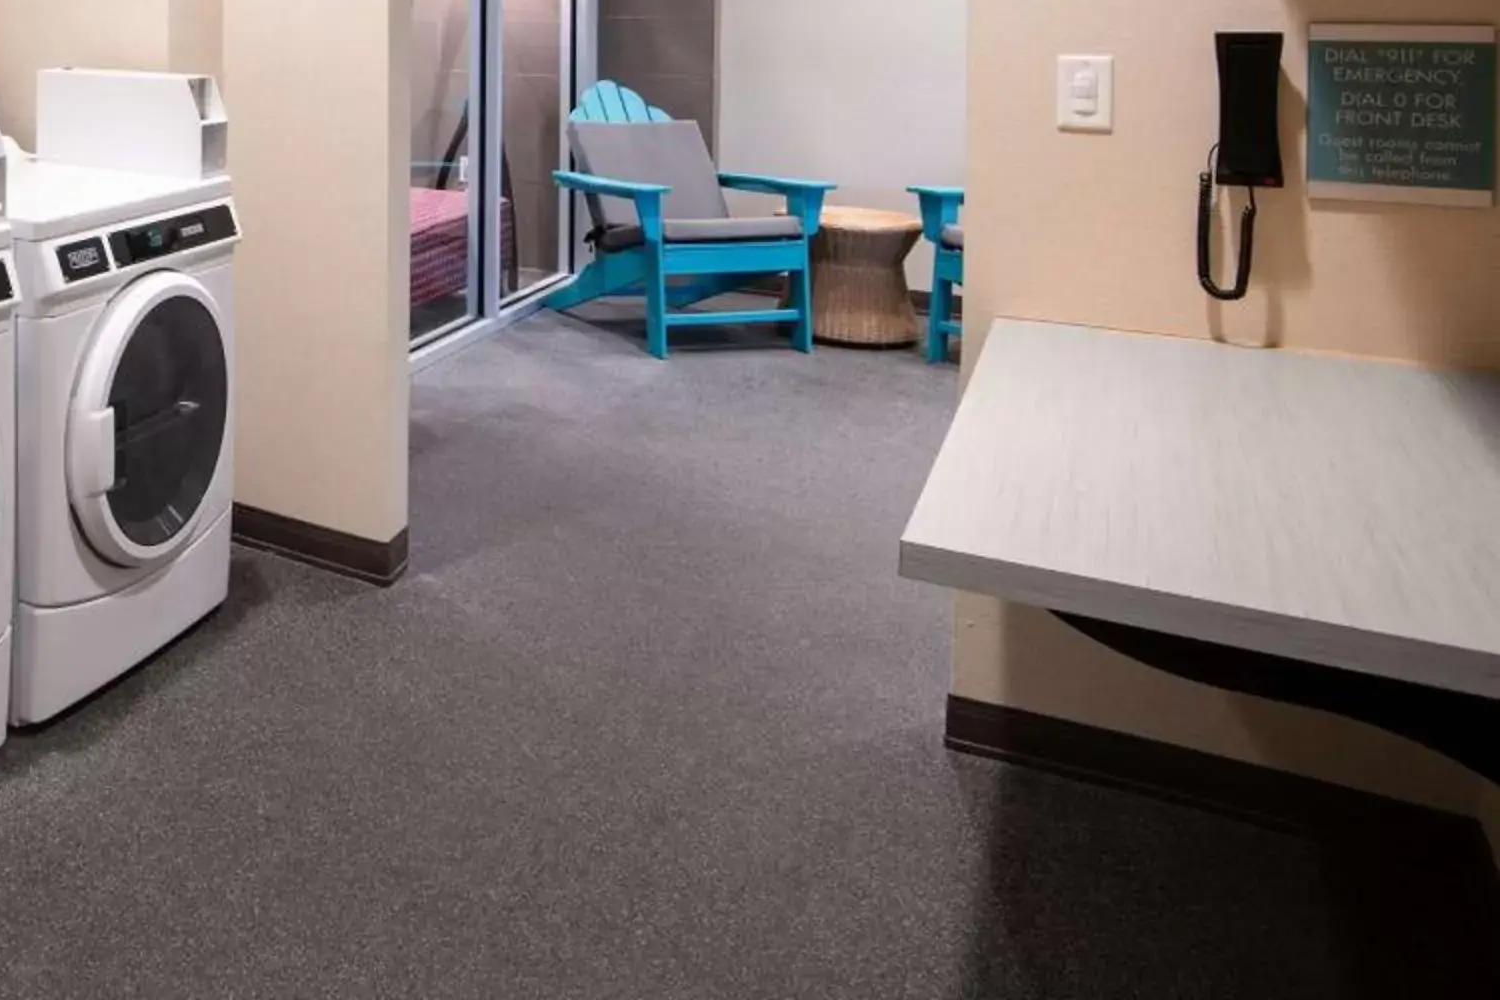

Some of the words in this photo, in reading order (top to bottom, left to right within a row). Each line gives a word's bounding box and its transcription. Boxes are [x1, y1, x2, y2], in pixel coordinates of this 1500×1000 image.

[1324, 48, 1368, 64] DIAL
[1432, 49, 1476, 65] FOR
[1341, 91, 1387, 108] DIAL
[1414, 93, 1457, 110] FOR
[1336, 110, 1403, 127] FRONT
[1411, 112, 1463, 129] DESK
[1318, 133, 1363, 148] Guest
[1366, 150, 1413, 164] called
[1420, 152, 1458, 166] from
